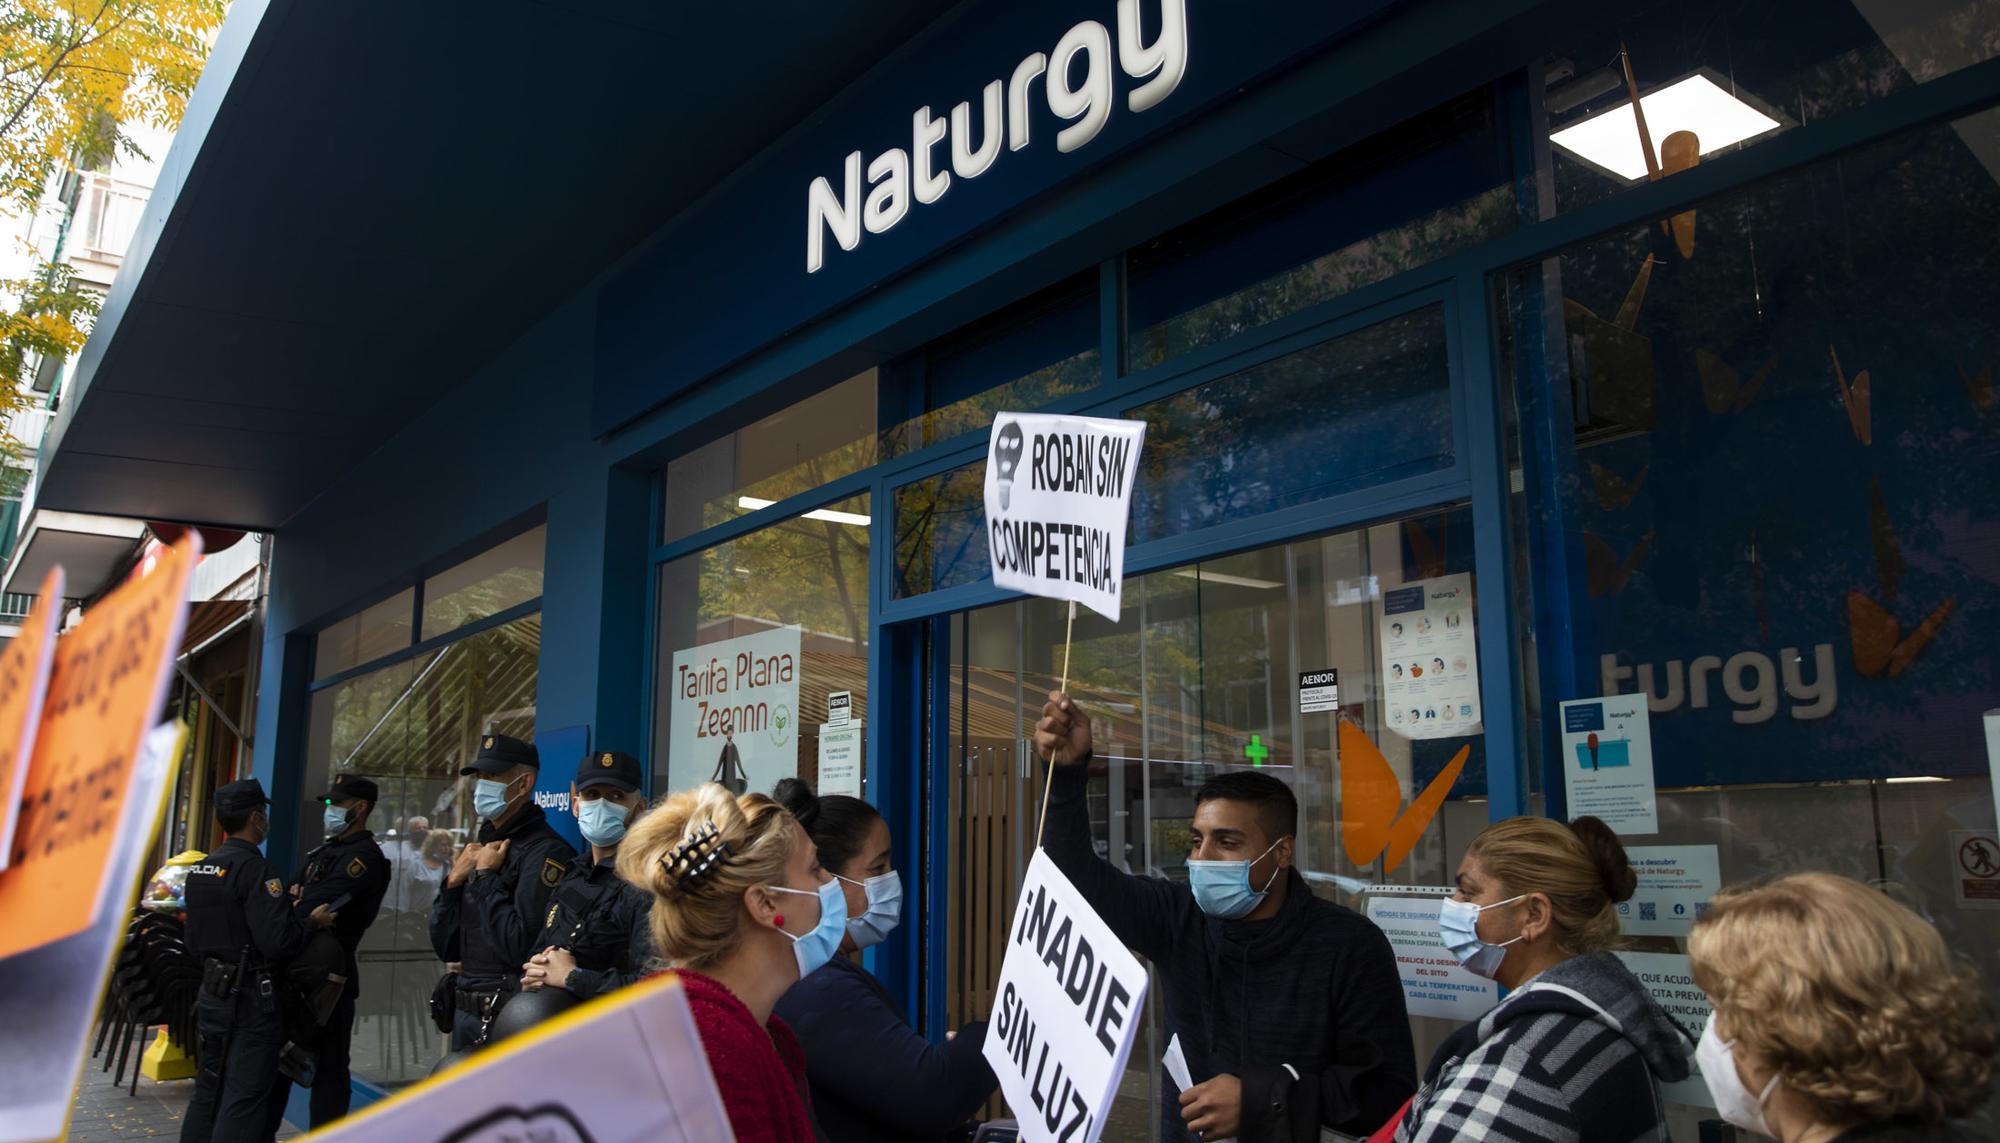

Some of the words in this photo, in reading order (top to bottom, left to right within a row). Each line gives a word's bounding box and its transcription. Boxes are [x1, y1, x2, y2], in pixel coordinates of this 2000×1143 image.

[807, 0, 1188, 273] Naturgy
[1031, 433, 1094, 495] ROBAN
[1096, 435, 1131, 498] SIN
[991, 517, 1116, 595] COMPETENCIA.
[678, 657, 728, 700] Tarifa
[735, 651, 793, 691] Plana
[1301, 672, 1334, 685] AENOR
[696, 701, 768, 738] Zeennn
[534, 791, 570, 811] Naturgy
[1645, 858, 1677, 866] descubrir
[1397, 956, 1425, 965] REALICE
[1016, 884, 1131, 1058] ¡NADIE
[1416, 968, 1429, 976] DEL
[1430, 969, 1449, 977] SITIO
[1641, 973, 1661, 984] QUE
[1429, 982, 1480, 992] TEMPERATURA
[1481, 985, 1487, 993] A
[1651, 988, 1673, 999] CITA
[1408, 991, 1427, 999] CADA
[1428, 992, 1457, 1002] CLIENTE
[997, 981, 1036, 1080] SIN
